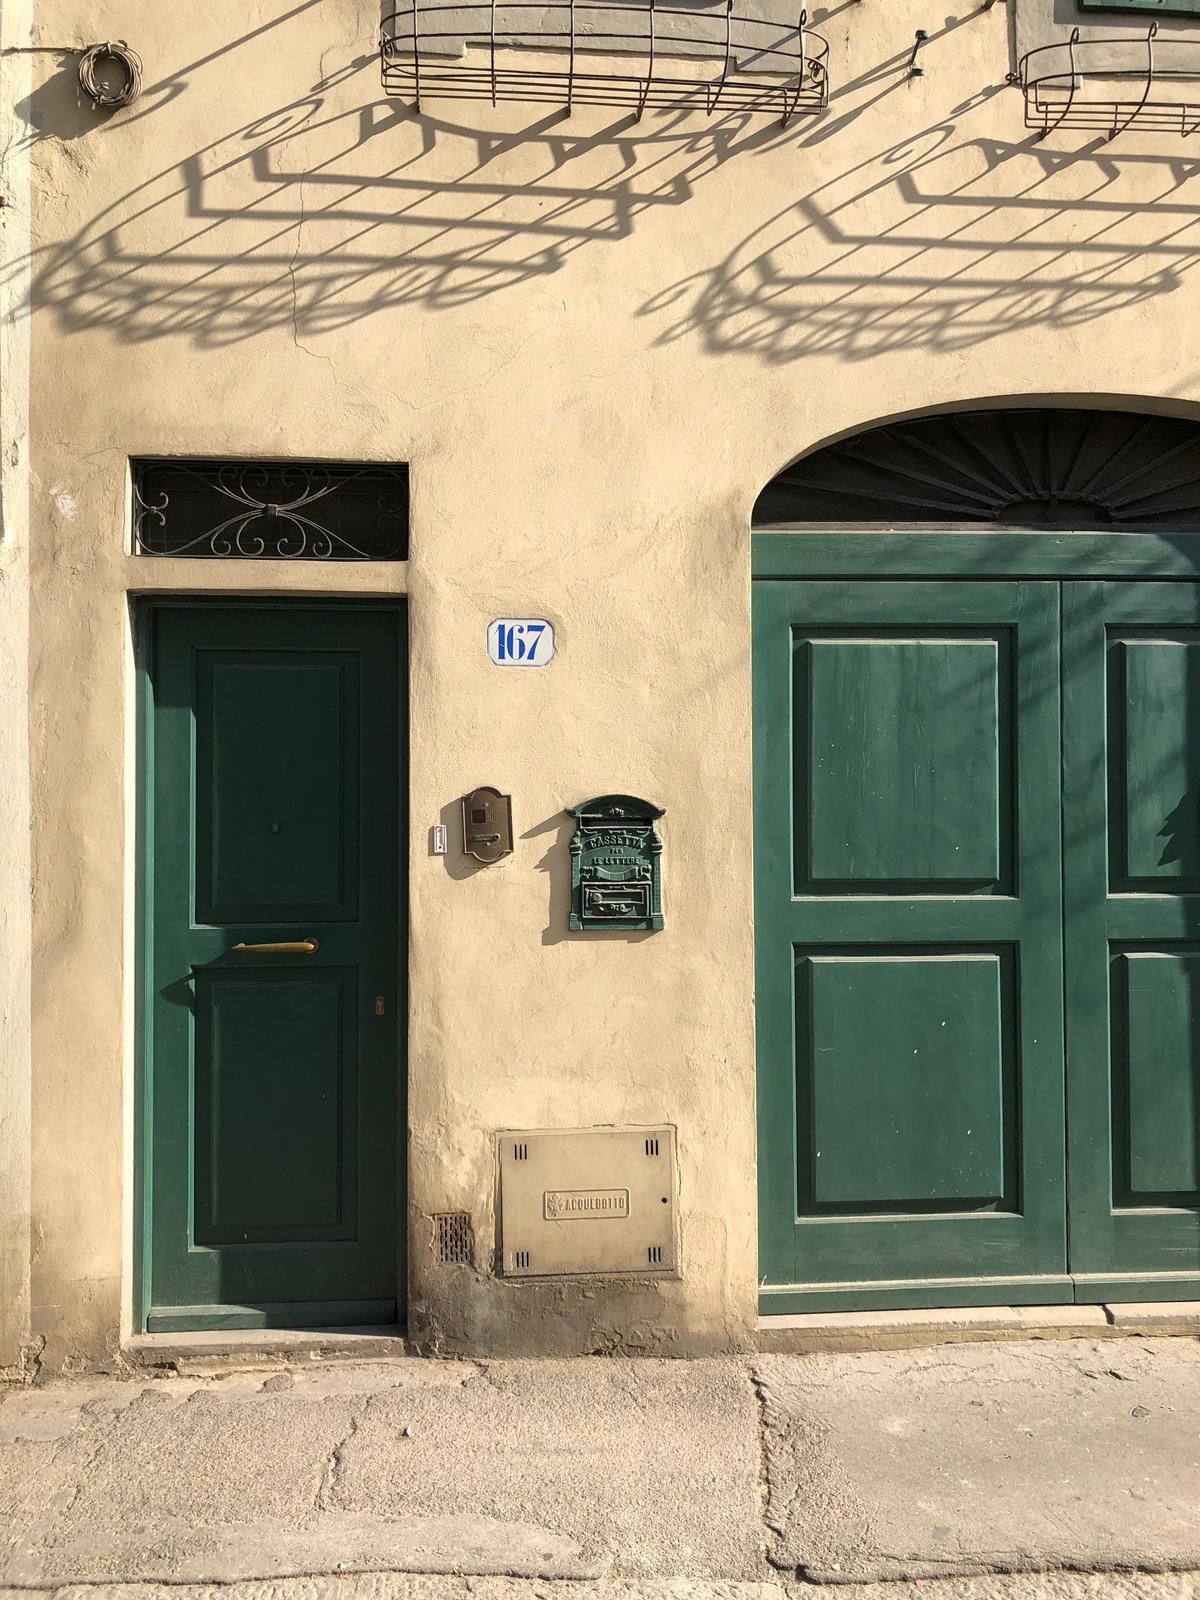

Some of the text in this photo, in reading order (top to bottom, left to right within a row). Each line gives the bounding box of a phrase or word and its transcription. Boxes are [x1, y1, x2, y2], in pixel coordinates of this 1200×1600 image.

[494, 624, 546, 660] 167
[590, 835, 644, 849] CASSETTA
[593, 856, 640, 865] LE LETTERE
[565, 1197, 626, 1211] ACQUEDOTTO
